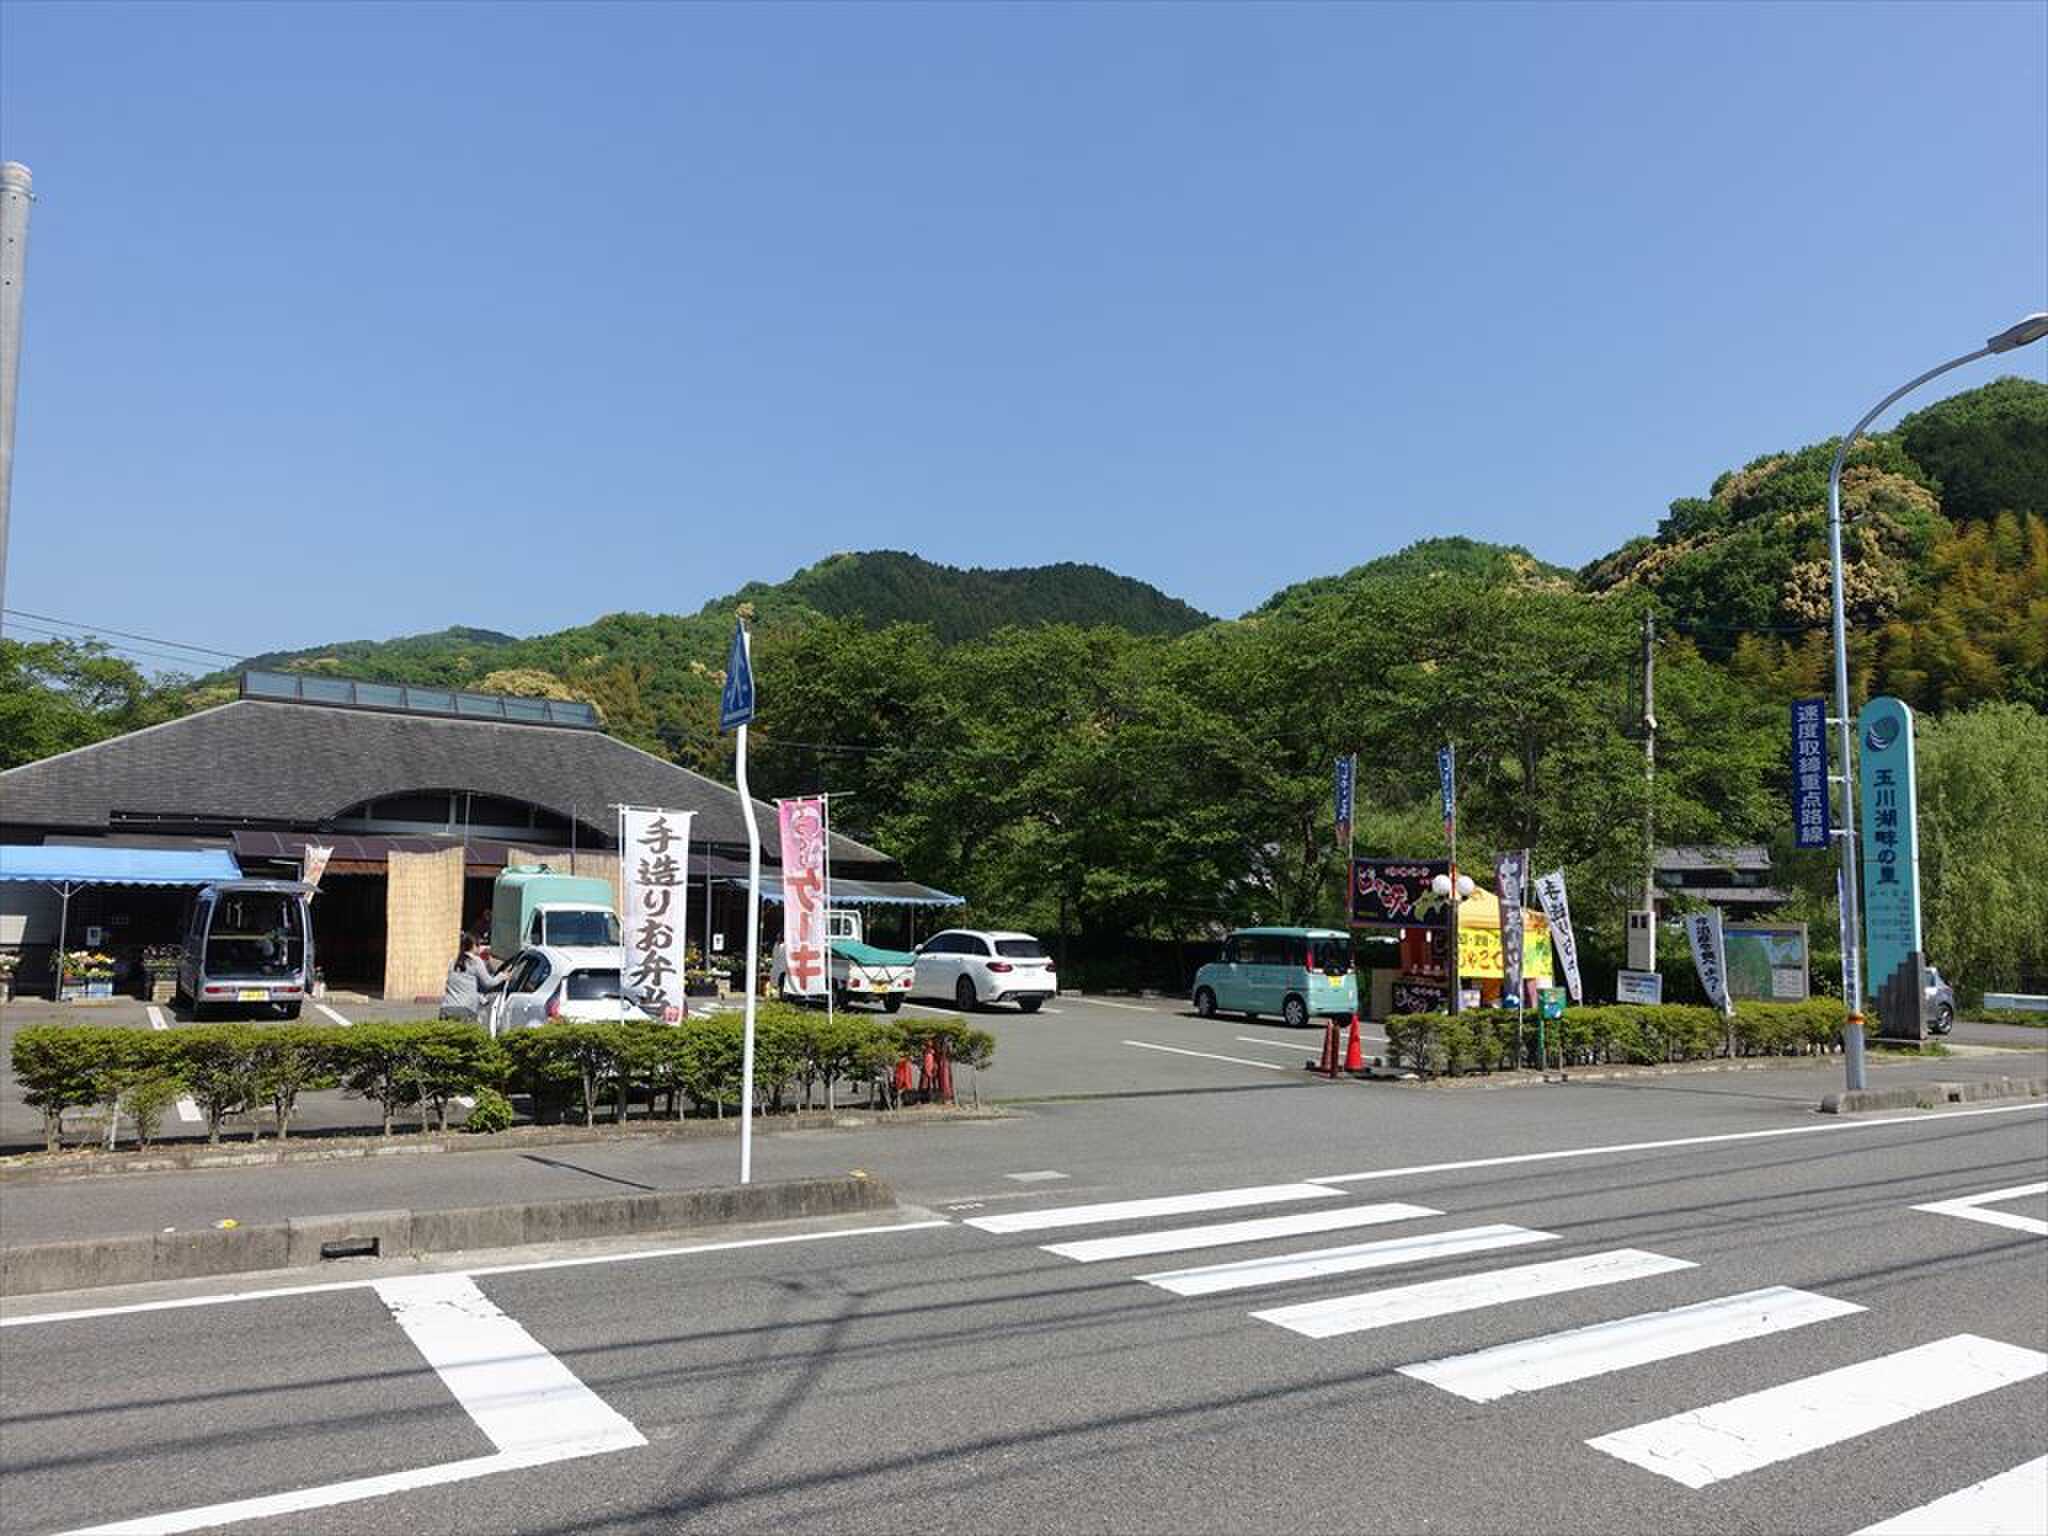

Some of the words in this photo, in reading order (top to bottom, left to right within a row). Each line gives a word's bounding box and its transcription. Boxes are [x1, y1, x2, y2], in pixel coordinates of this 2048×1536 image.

[1797, 705, 1823, 842] 速度取締重点路線
[1873, 769, 1899, 885] 玉川湖畔の里
[631, 816, 683, 1016] 手造りお弁当
